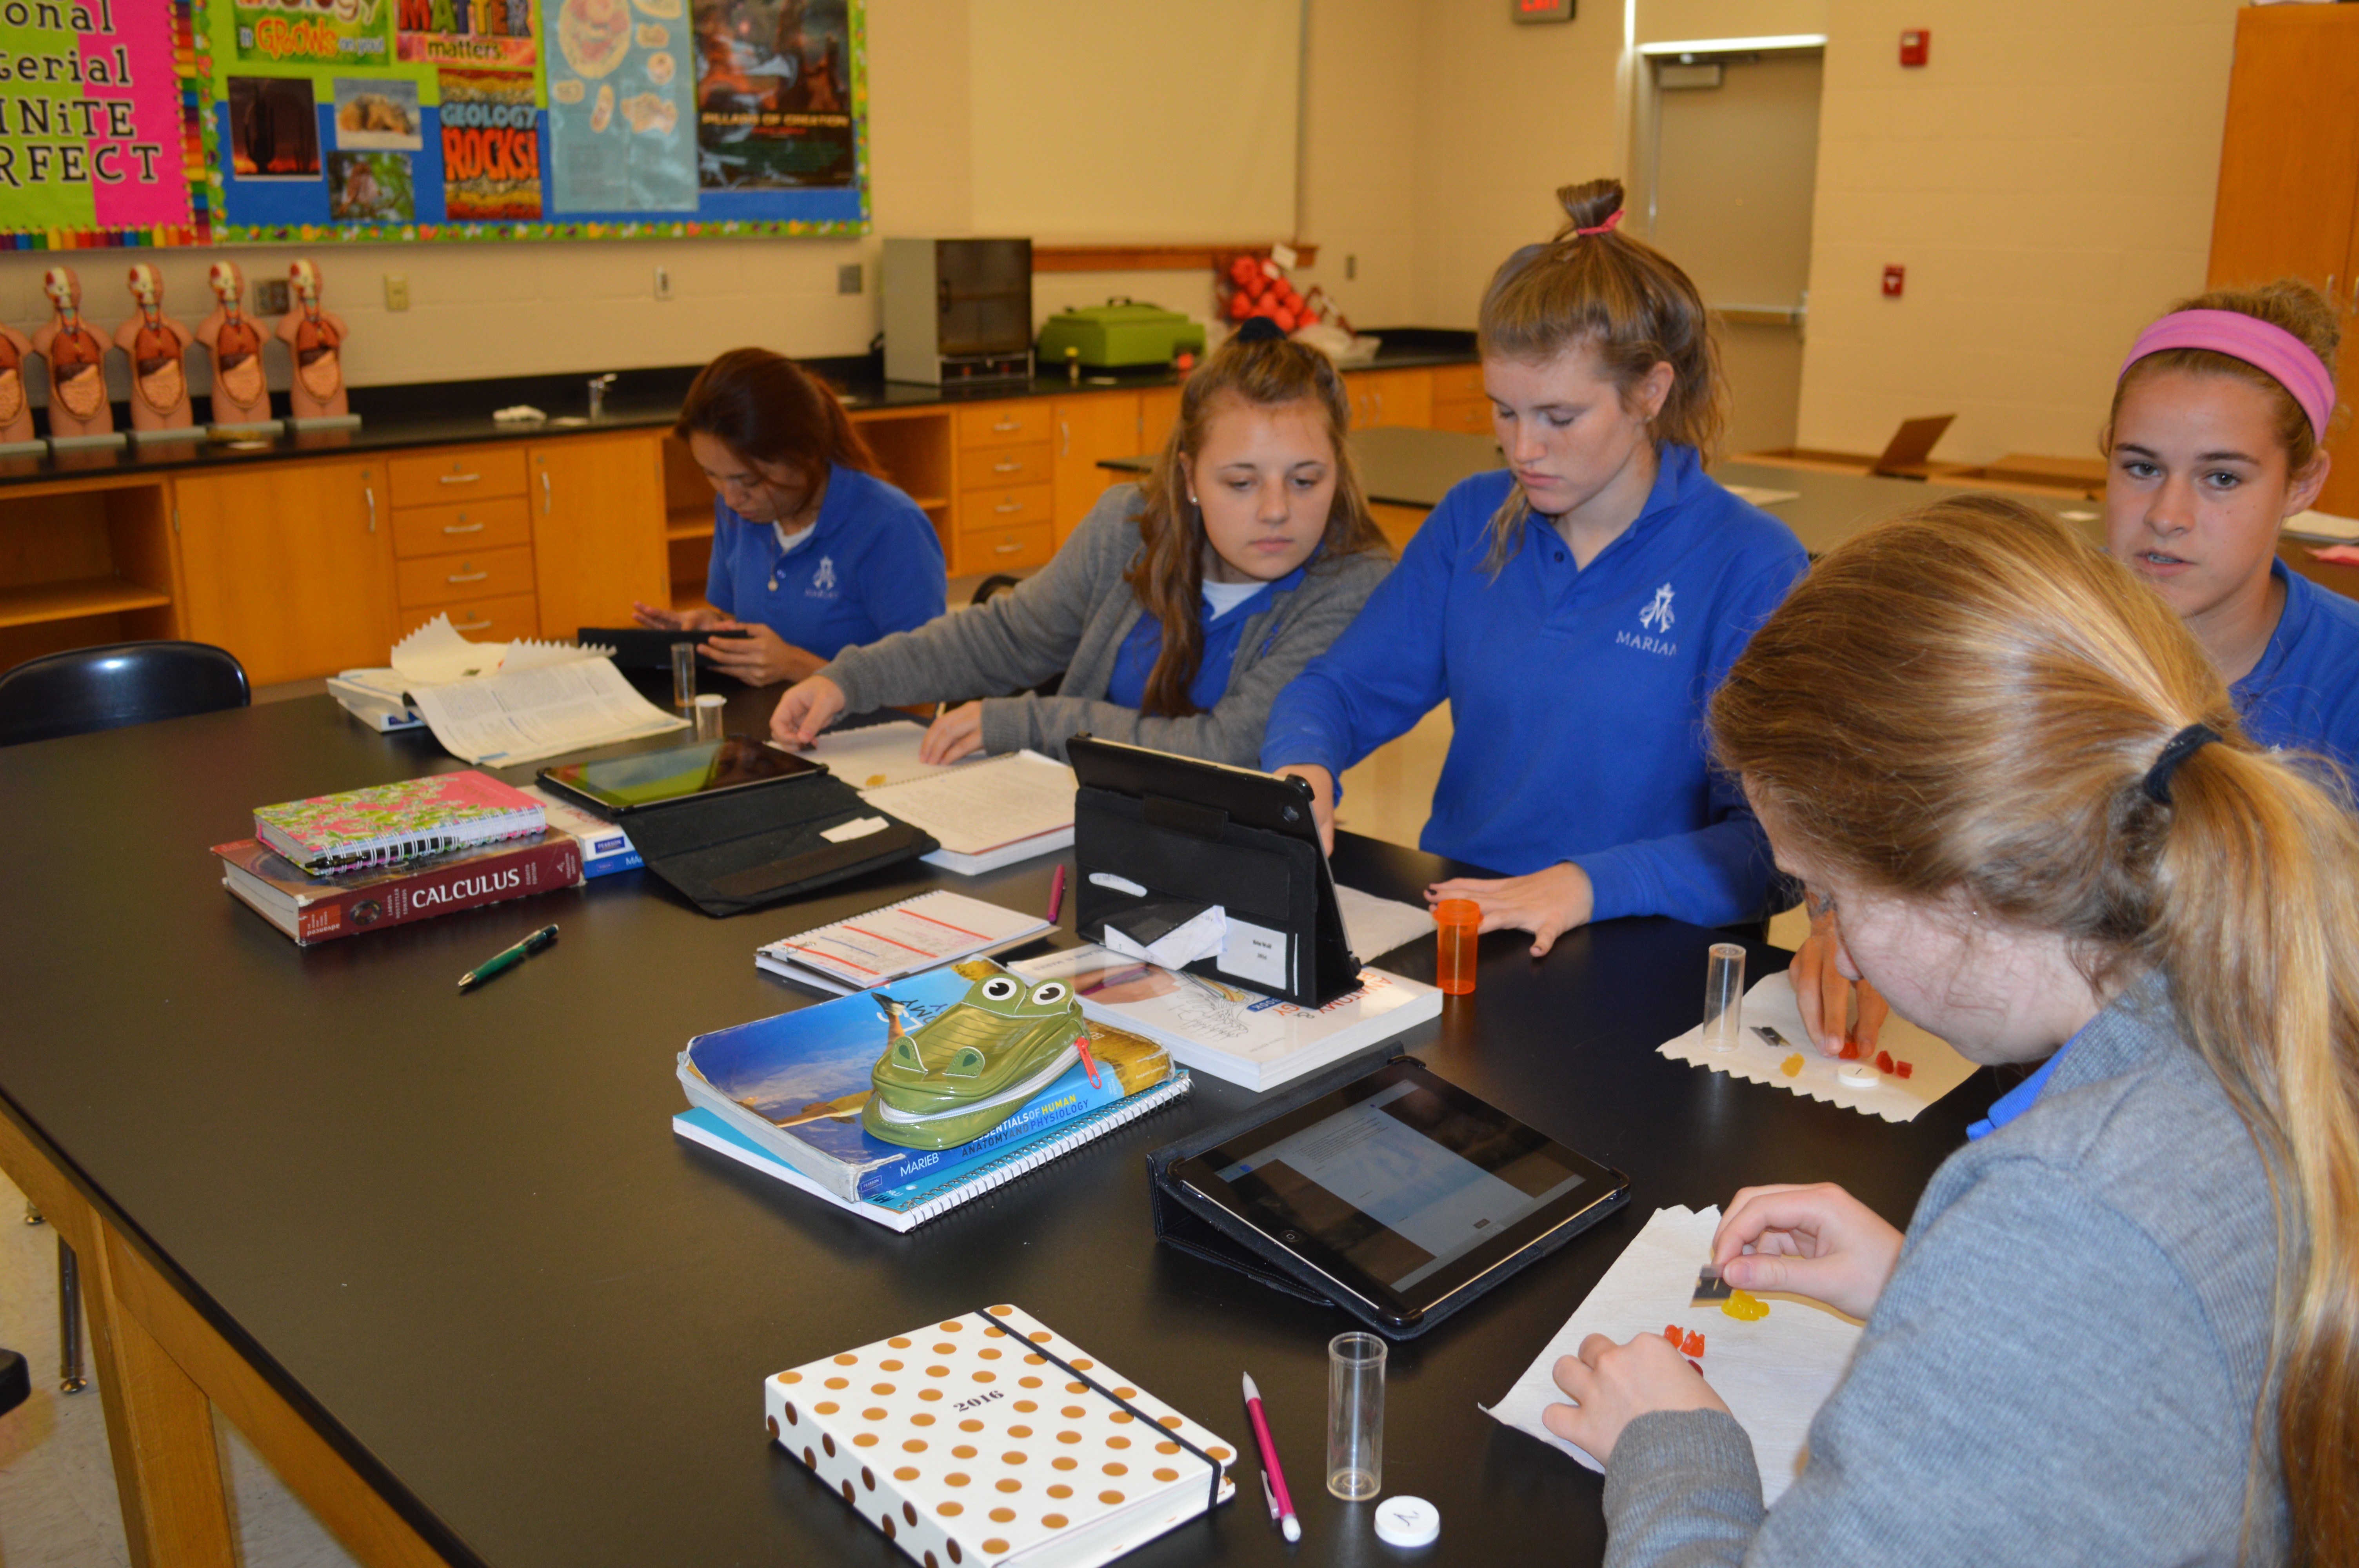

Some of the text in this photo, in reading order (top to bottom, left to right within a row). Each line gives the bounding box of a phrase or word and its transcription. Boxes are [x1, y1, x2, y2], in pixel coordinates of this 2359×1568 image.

[441, 102, 537, 129] GEOLOGY
[442, 126, 540, 181] ROCKS!
[412, 868, 520, 908] CALCULUS
[1041, 1094, 1076, 1115] HUMAN
[961, 1099, 1089, 1157] ANATOMY AND PHYSIOLOGY
[901, 1152, 940, 1177] MARIEB
[863, 1178, 879, 1188] PEARSON
[953, 1390, 1004, 1412] 2016
